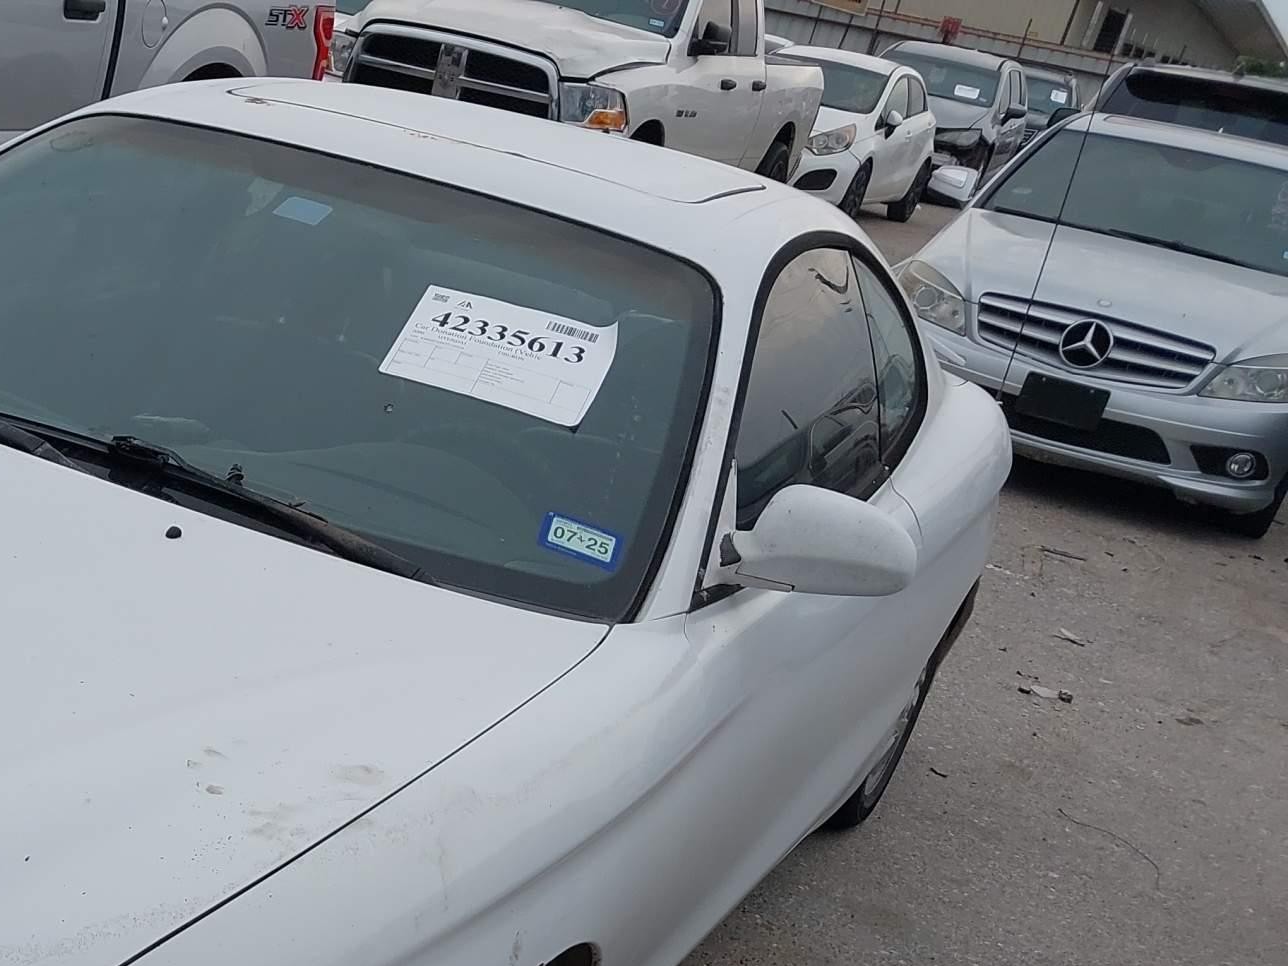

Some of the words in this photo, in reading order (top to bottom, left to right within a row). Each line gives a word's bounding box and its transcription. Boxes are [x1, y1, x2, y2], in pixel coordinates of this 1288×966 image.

[265, 6, 309, 29] STX
[431, 311, 586, 364] 42335613
[469, 334, 513, 352] Foundation
